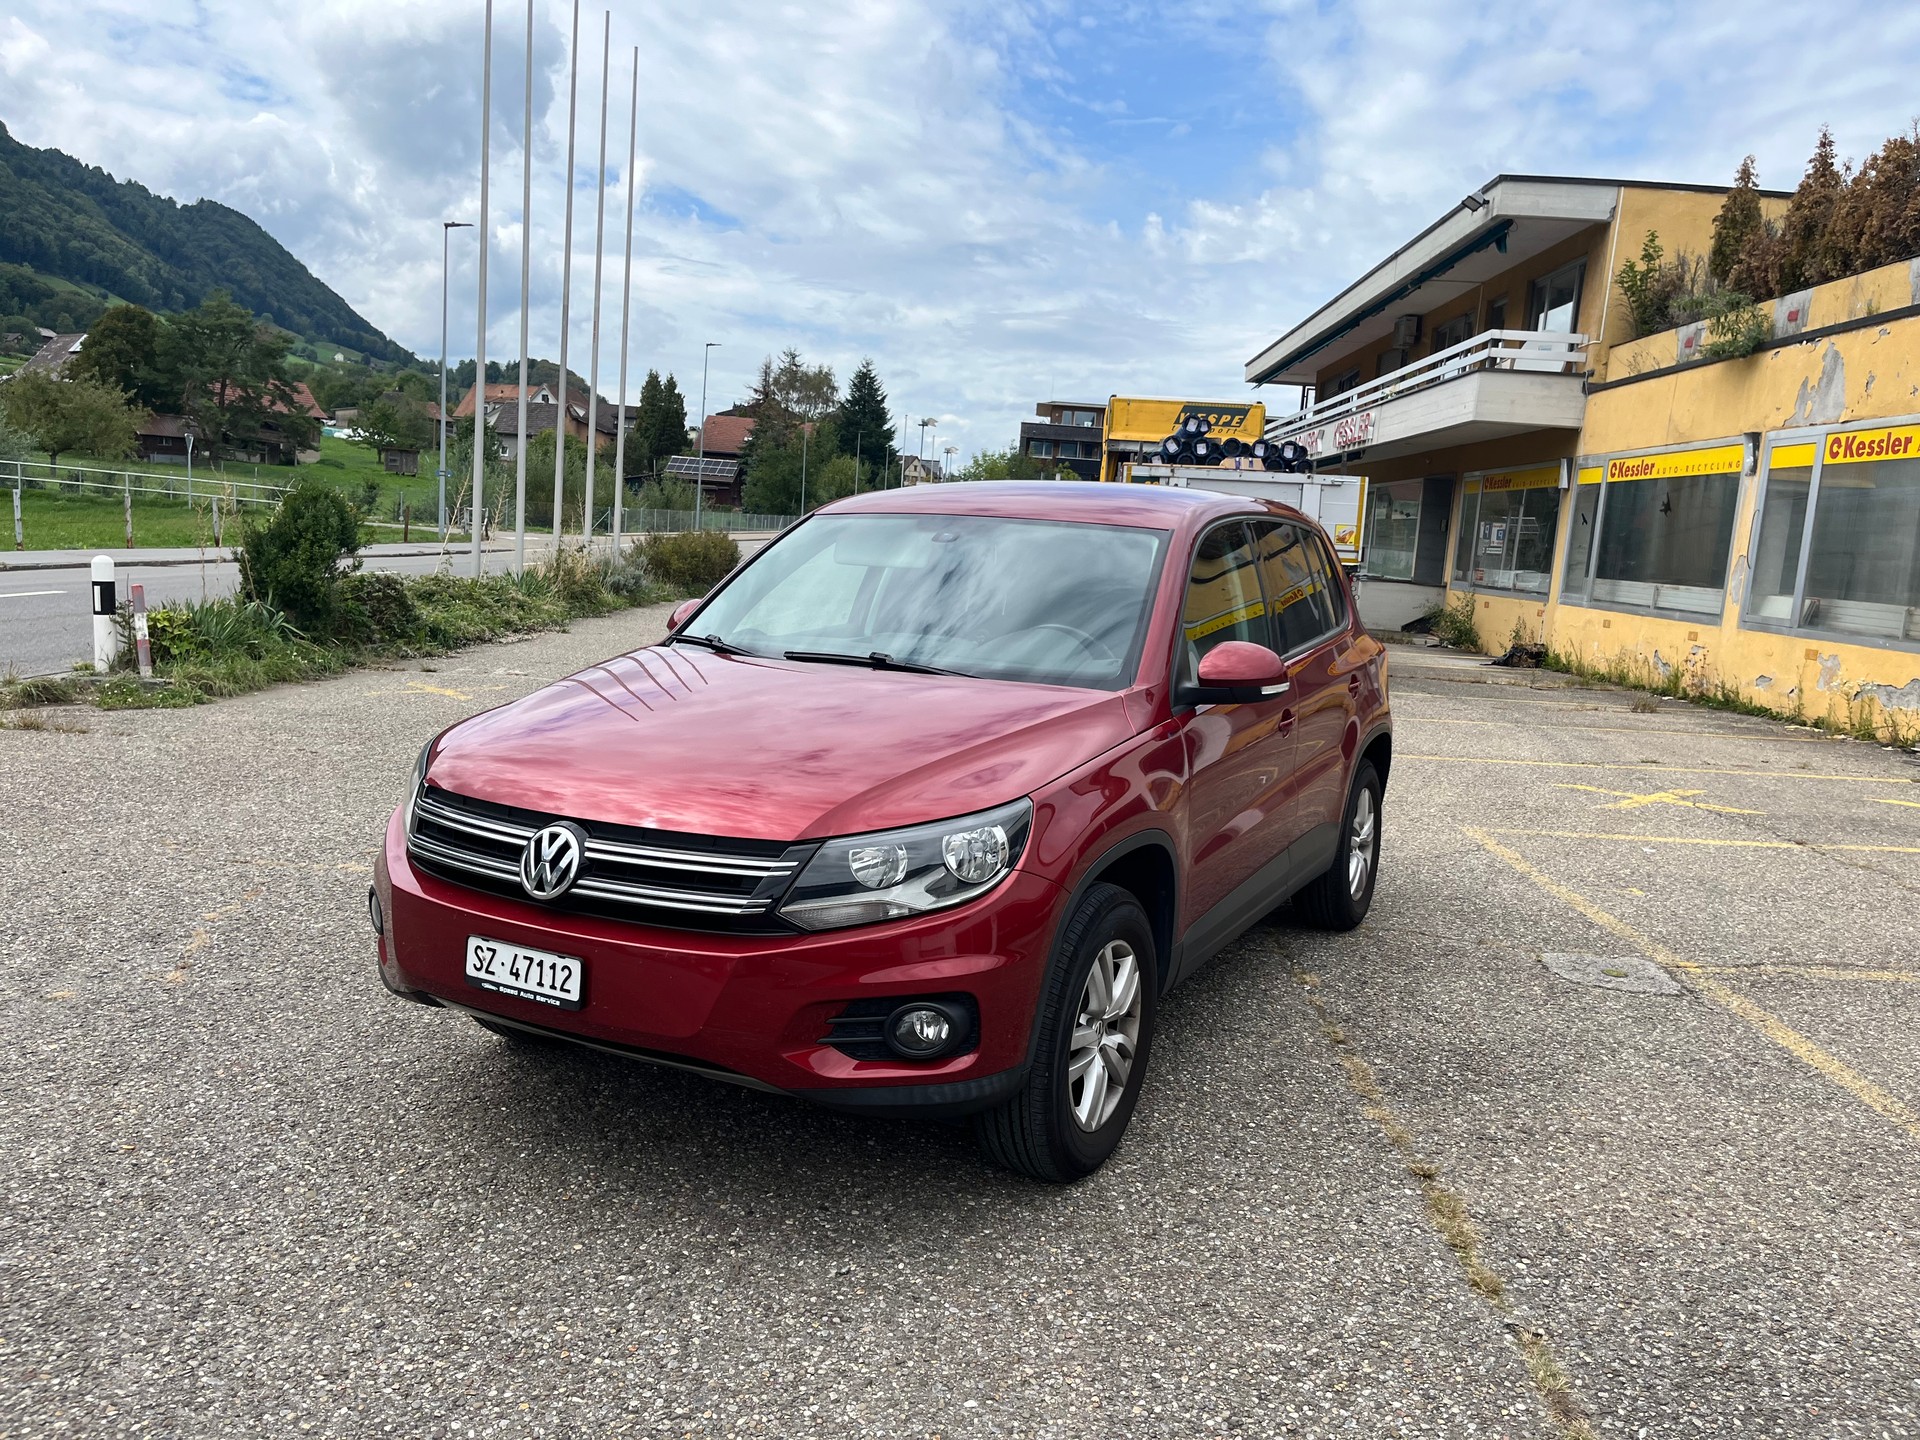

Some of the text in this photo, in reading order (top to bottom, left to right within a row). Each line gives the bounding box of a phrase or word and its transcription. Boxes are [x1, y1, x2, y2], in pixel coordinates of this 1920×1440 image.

[1171, 425, 1237, 434] tport
[1843, 432, 1913, 459] Kessler
[1617, 459, 1741, 478] Kessler AUTO-RECYCLING
[499, 986, 561, 1006] Speed Auto Service
